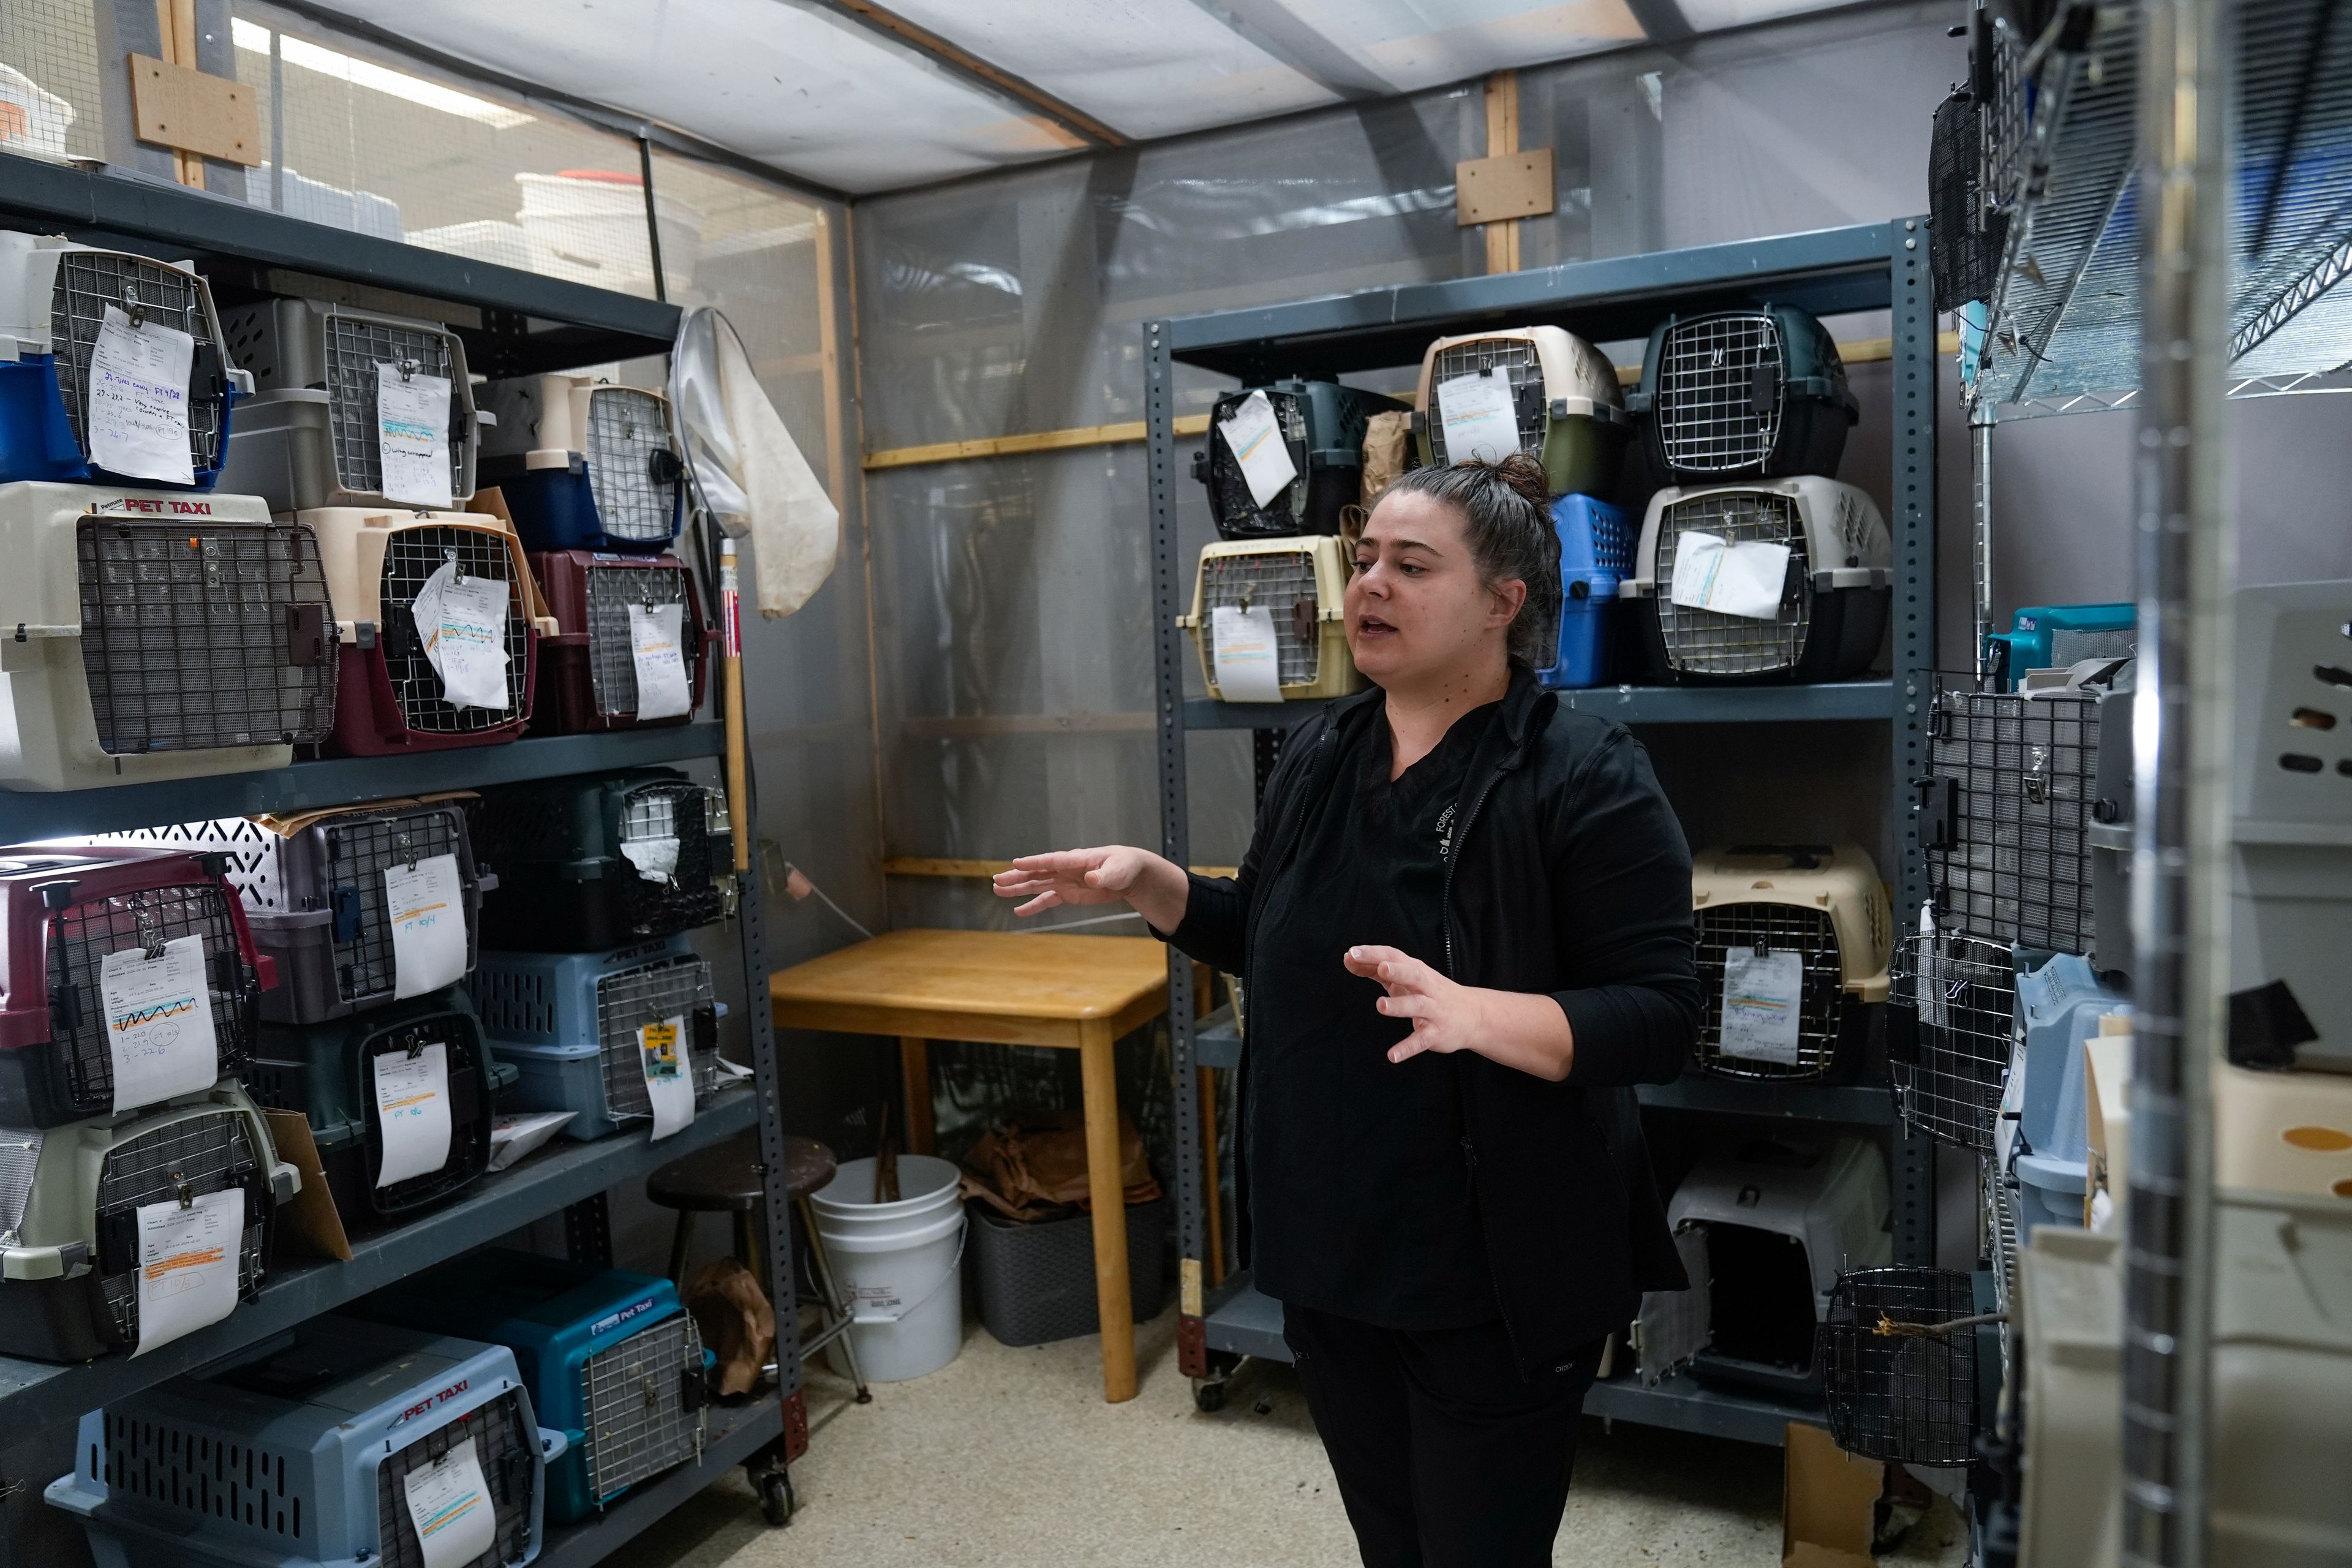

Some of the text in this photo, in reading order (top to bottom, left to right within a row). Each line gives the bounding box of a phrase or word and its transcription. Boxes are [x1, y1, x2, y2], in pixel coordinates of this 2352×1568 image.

[100, 498, 123, 510] Petmate
[124, 499, 211, 515] PET TAXI
[1436, 806, 1457, 832] FOREST
[419, 915, 435, 928] 10/4
[616, 940, 666, 962] PET TAXI
[151, 1274, 190, 1295] FT 10/5
[620, 1298, 652, 1321] Pet Taxi
[404, 1379, 468, 1421] PET TAXI
